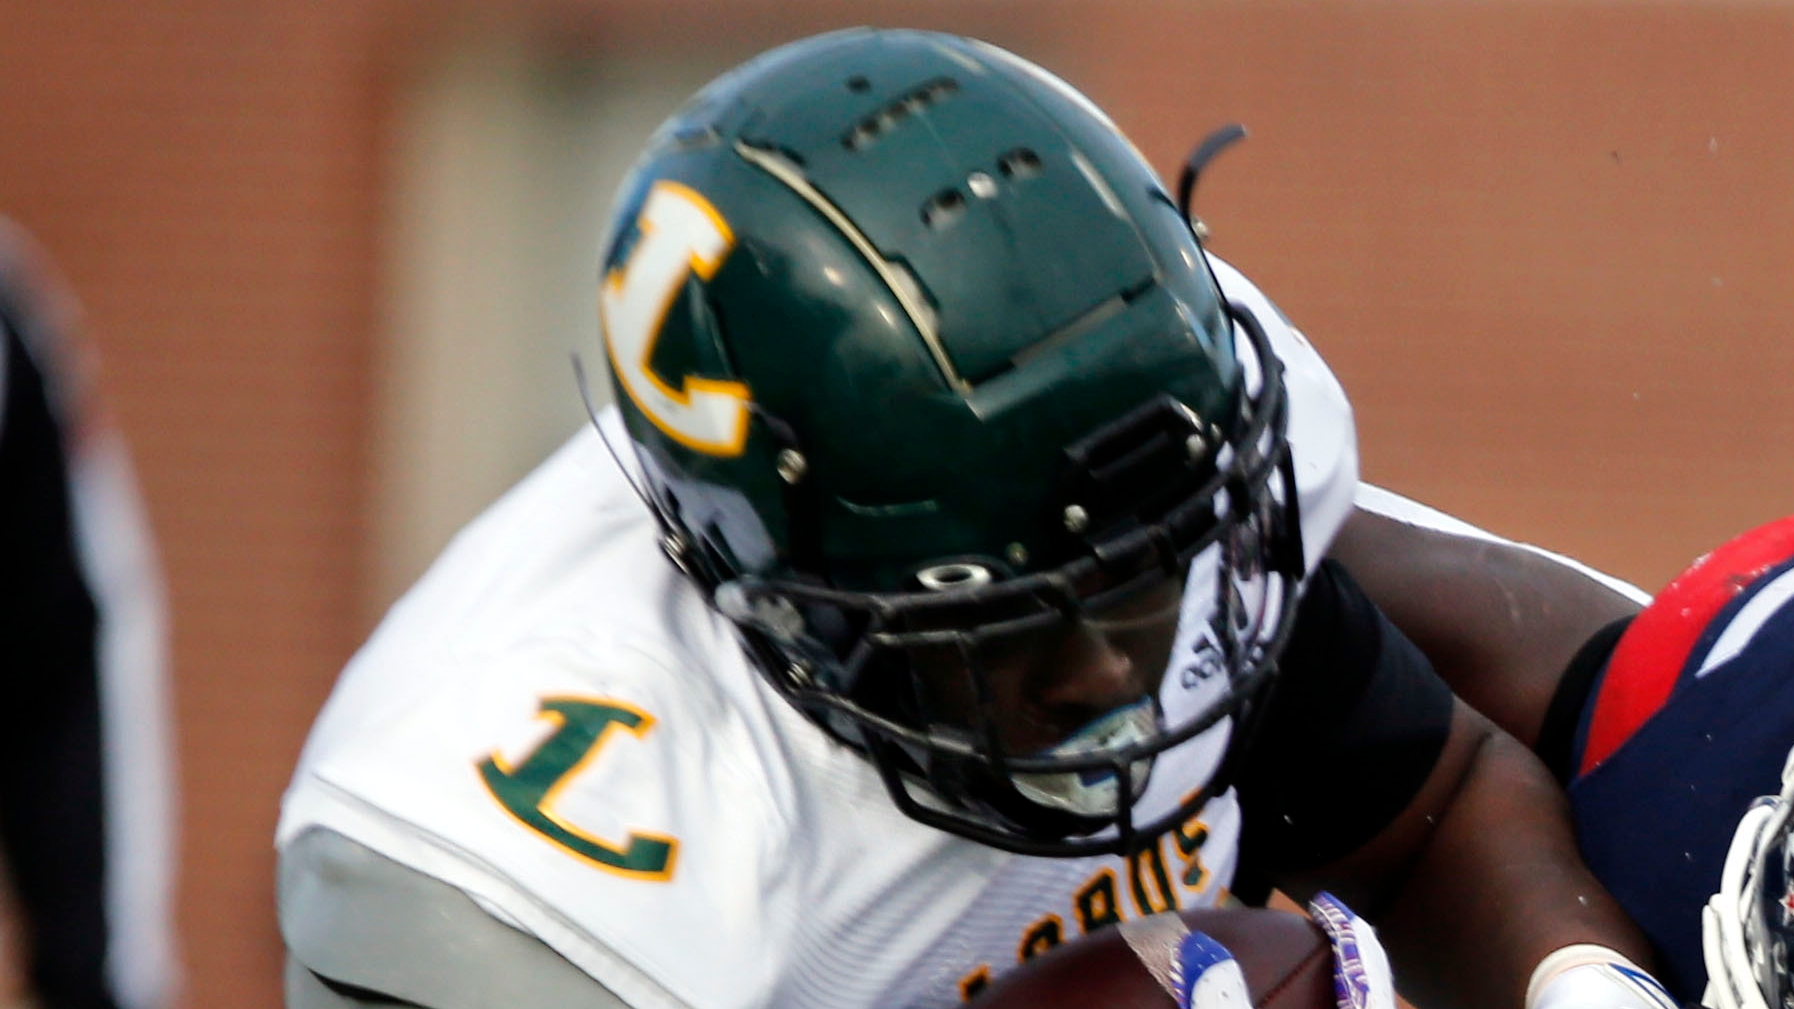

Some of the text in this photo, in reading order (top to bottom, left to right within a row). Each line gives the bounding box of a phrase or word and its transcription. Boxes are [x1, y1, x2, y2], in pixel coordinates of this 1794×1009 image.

[603, 179, 750, 458] L
[475, 694, 679, 884] L
[957, 784, 1212, 1004] BOS
